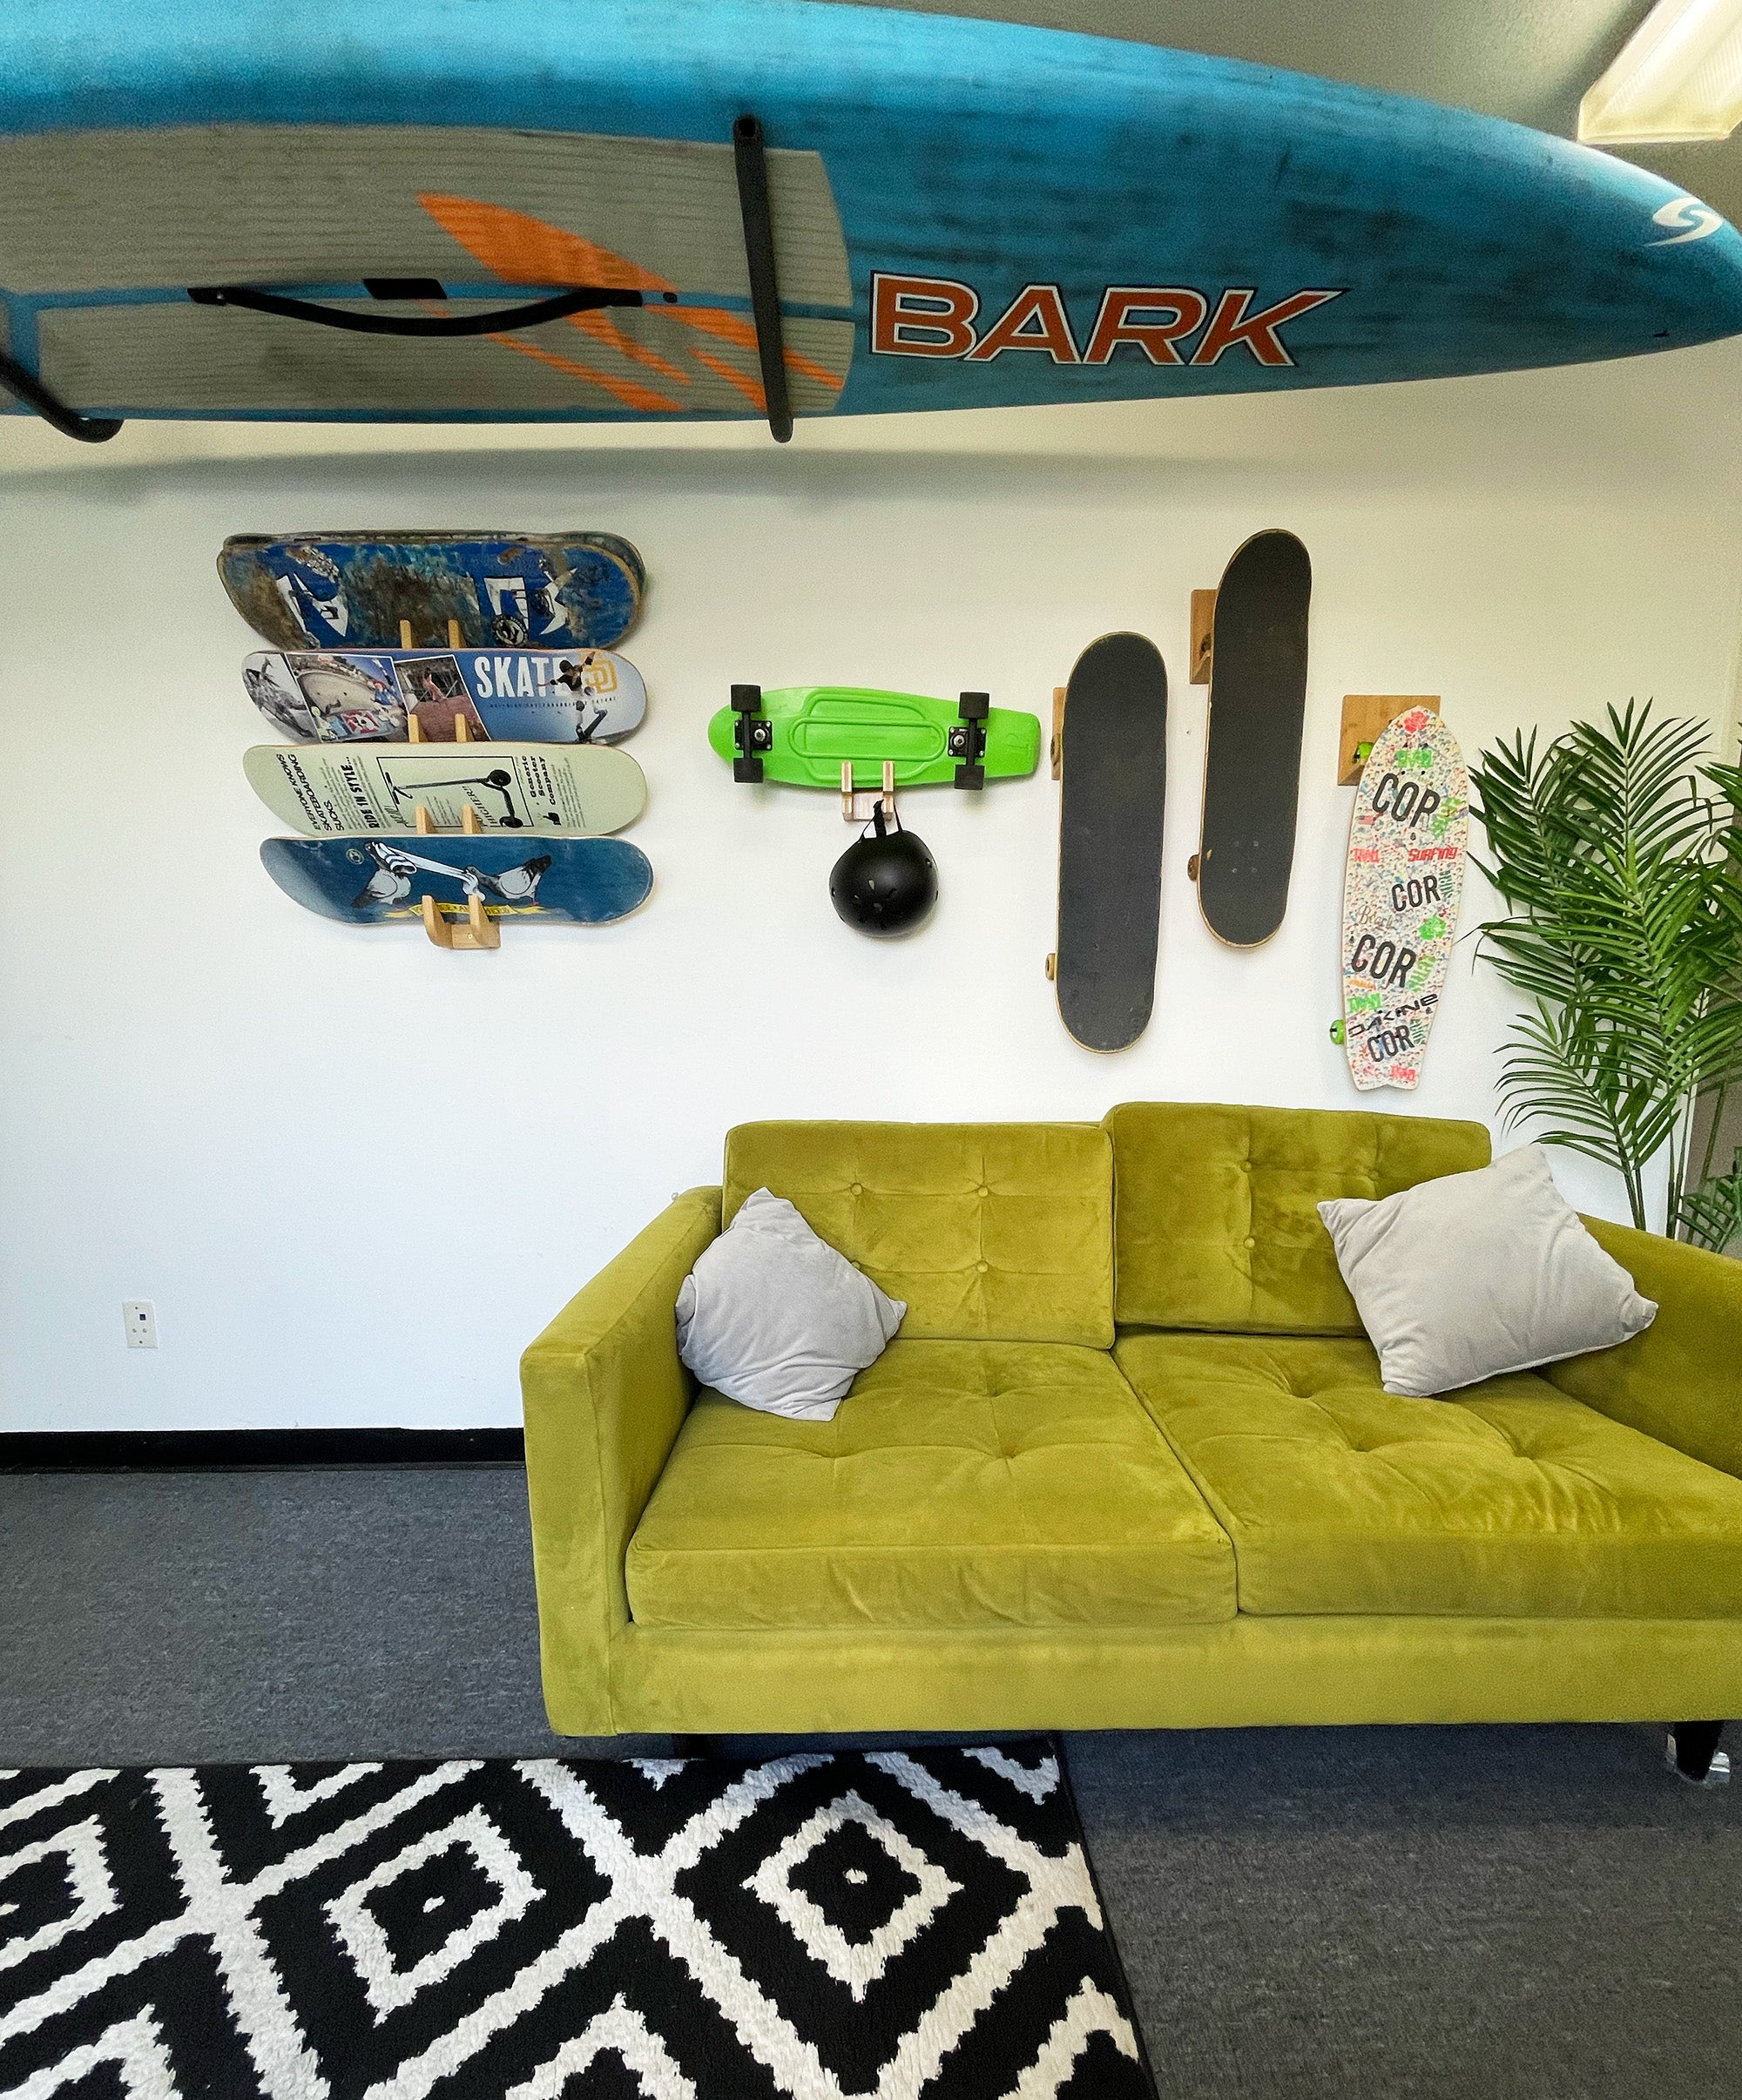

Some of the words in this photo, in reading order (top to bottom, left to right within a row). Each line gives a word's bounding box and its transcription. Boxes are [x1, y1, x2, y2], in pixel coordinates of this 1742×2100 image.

[871, 270, 1348, 367] BARK
[276, 753, 298, 787] KNOWS
[522, 755, 537, 798] Generic
[530, 755, 545, 797] Scooter
[539, 756, 556, 806] Company
[288, 754, 332, 831] SKATEBOARDING
[294, 787, 321, 830] EVERYONE
[361, 809, 380, 828] RIDE
[1391, 874, 1441, 912] COR
[1351, 934, 1416, 988] COR
[1367, 1024, 1415, 1063] COR
